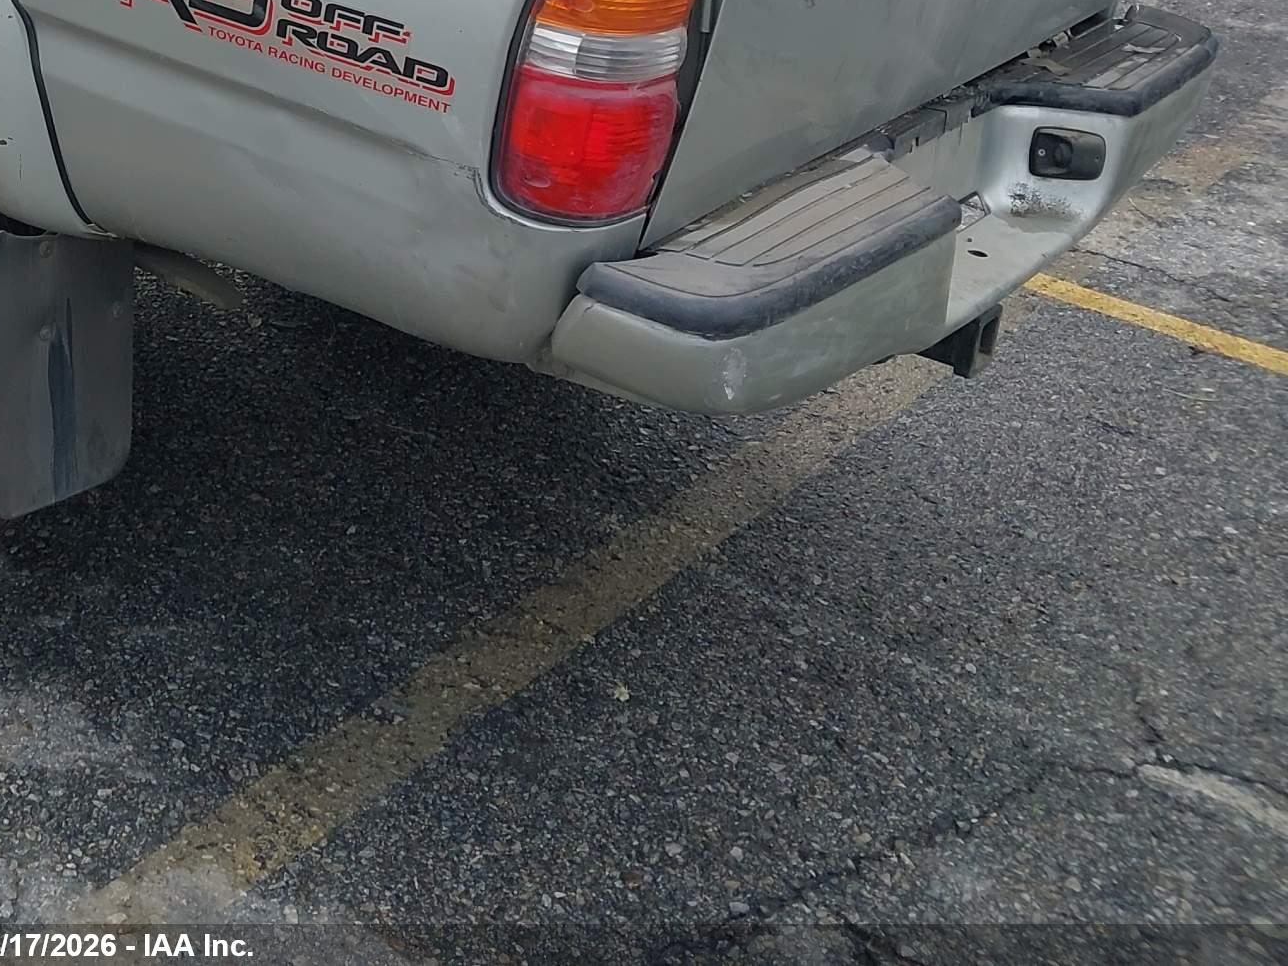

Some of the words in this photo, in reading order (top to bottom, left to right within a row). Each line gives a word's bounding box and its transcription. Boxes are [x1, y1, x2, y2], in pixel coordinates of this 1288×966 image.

[208, 26, 263, 54] TOYOTA
[267, 45, 326, 74] RACING
[331, 67, 452, 114] DEVELOPMENT
[276, 18, 456, 97] ROAD
